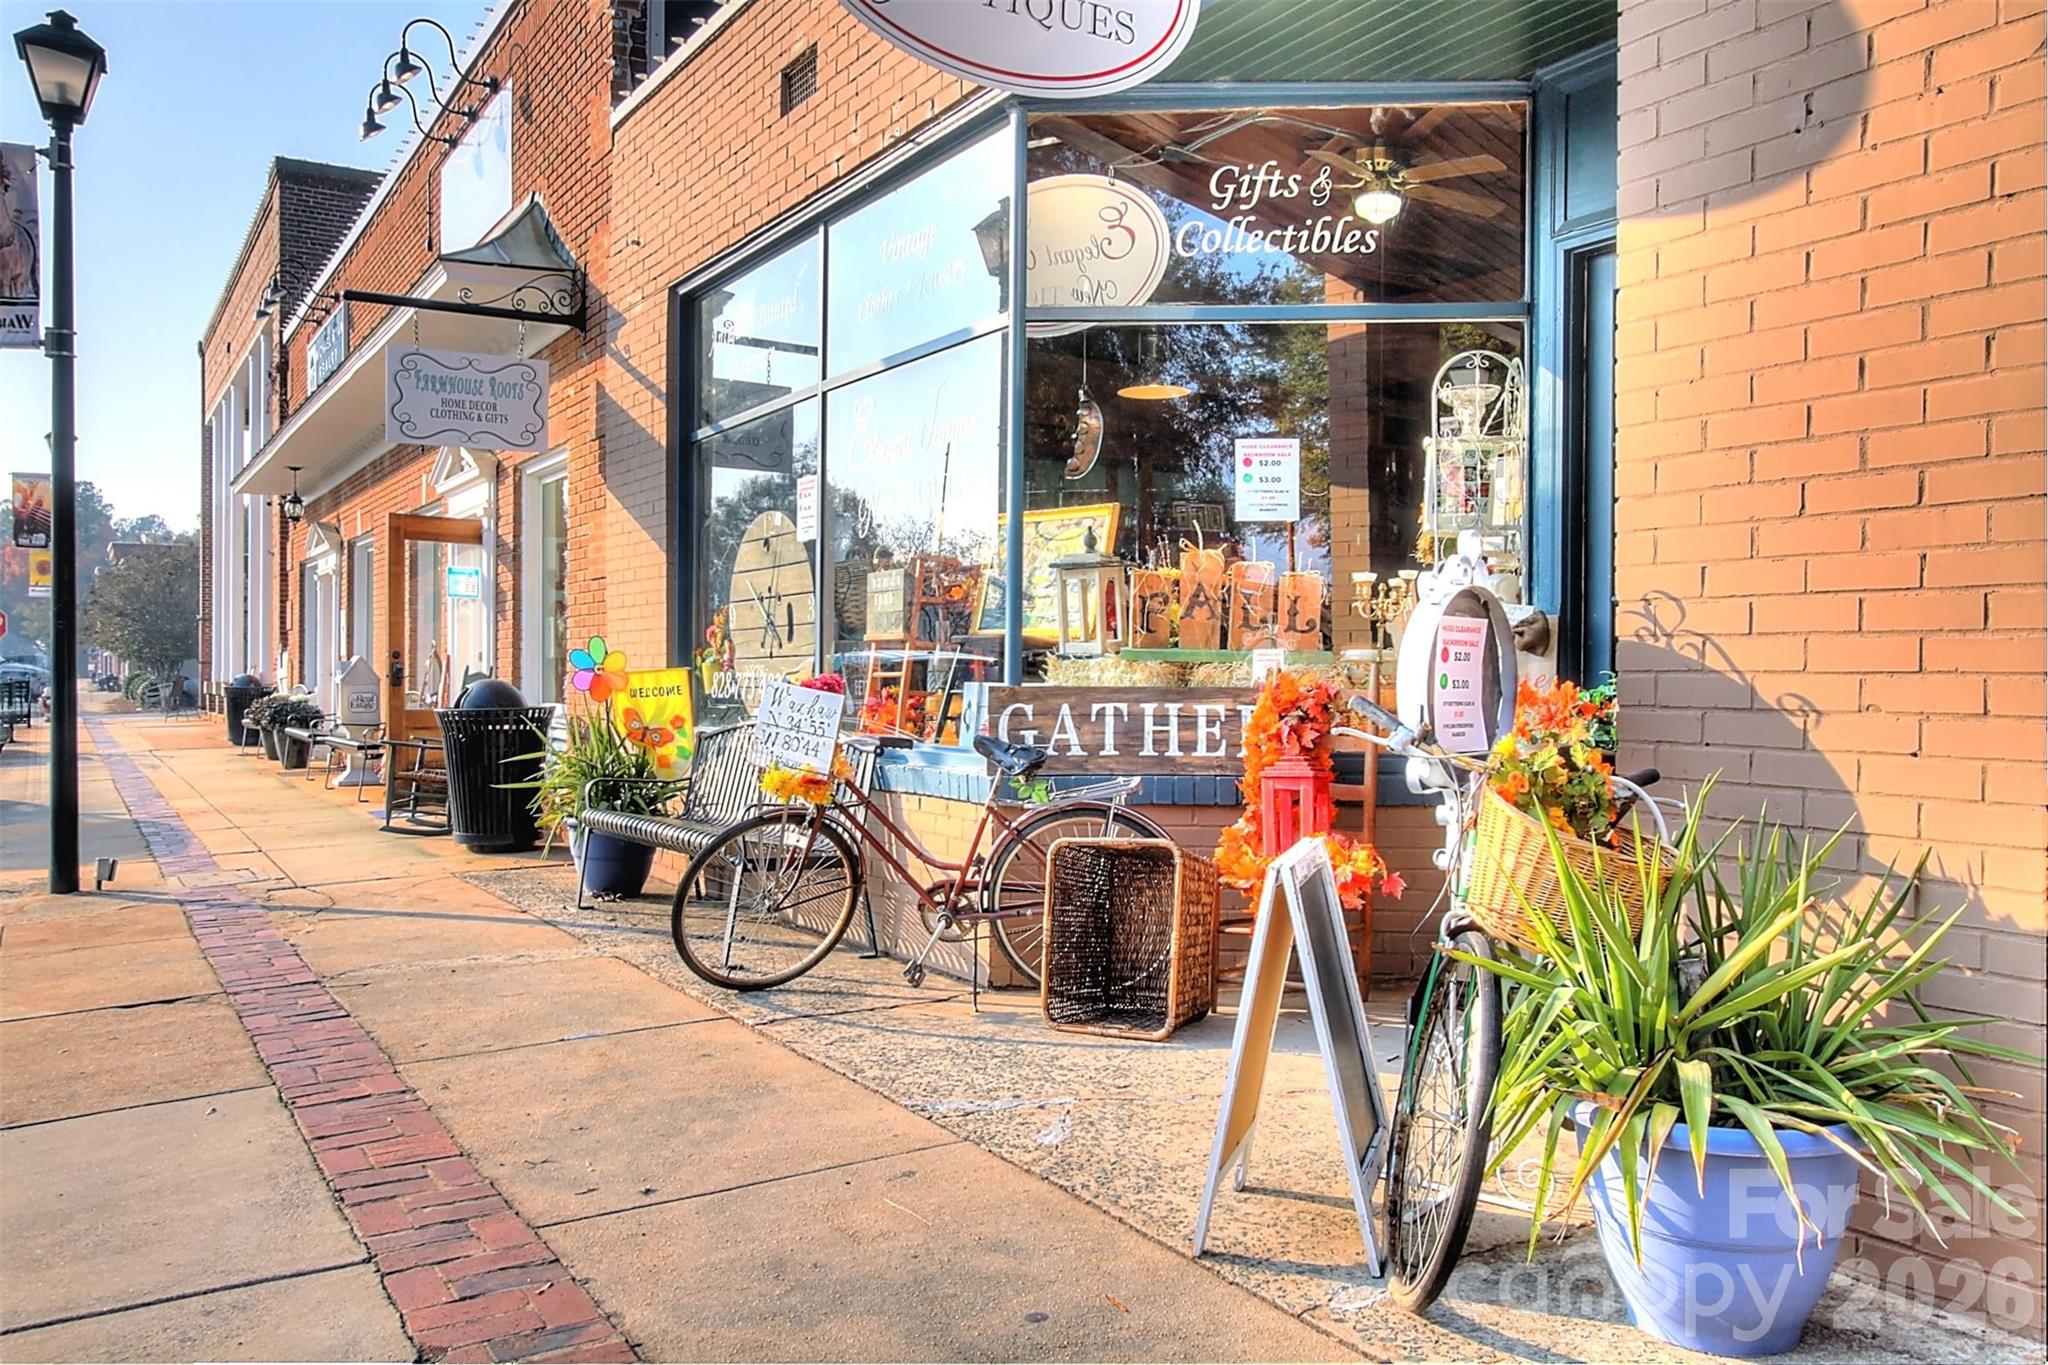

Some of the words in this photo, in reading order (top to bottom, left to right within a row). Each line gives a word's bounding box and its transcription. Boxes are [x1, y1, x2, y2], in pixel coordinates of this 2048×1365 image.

[982, 0, 1136, 45] QUES
[1208, 160, 1302, 210] Gifts
[1309, 165, 1333, 207] &
[1175, 215, 1380, 258] Collectibles
[489, 375, 525, 401] ROOTS
[440, 398, 467, 410] HOME
[469, 400, 498, 412] DECOR
[430, 409, 475, 422] CLOTHING
[477, 413, 483, 422] &
[485, 413, 509, 424] GIFTS
[1258, 459, 1282, 467] $2.00
[1258, 476, 1282, 484] $3.00
[1453, 651, 1471, 662] $2.00
[629, 685, 682, 698] WELCOME
[1452, 679, 1470, 690] $3.00
